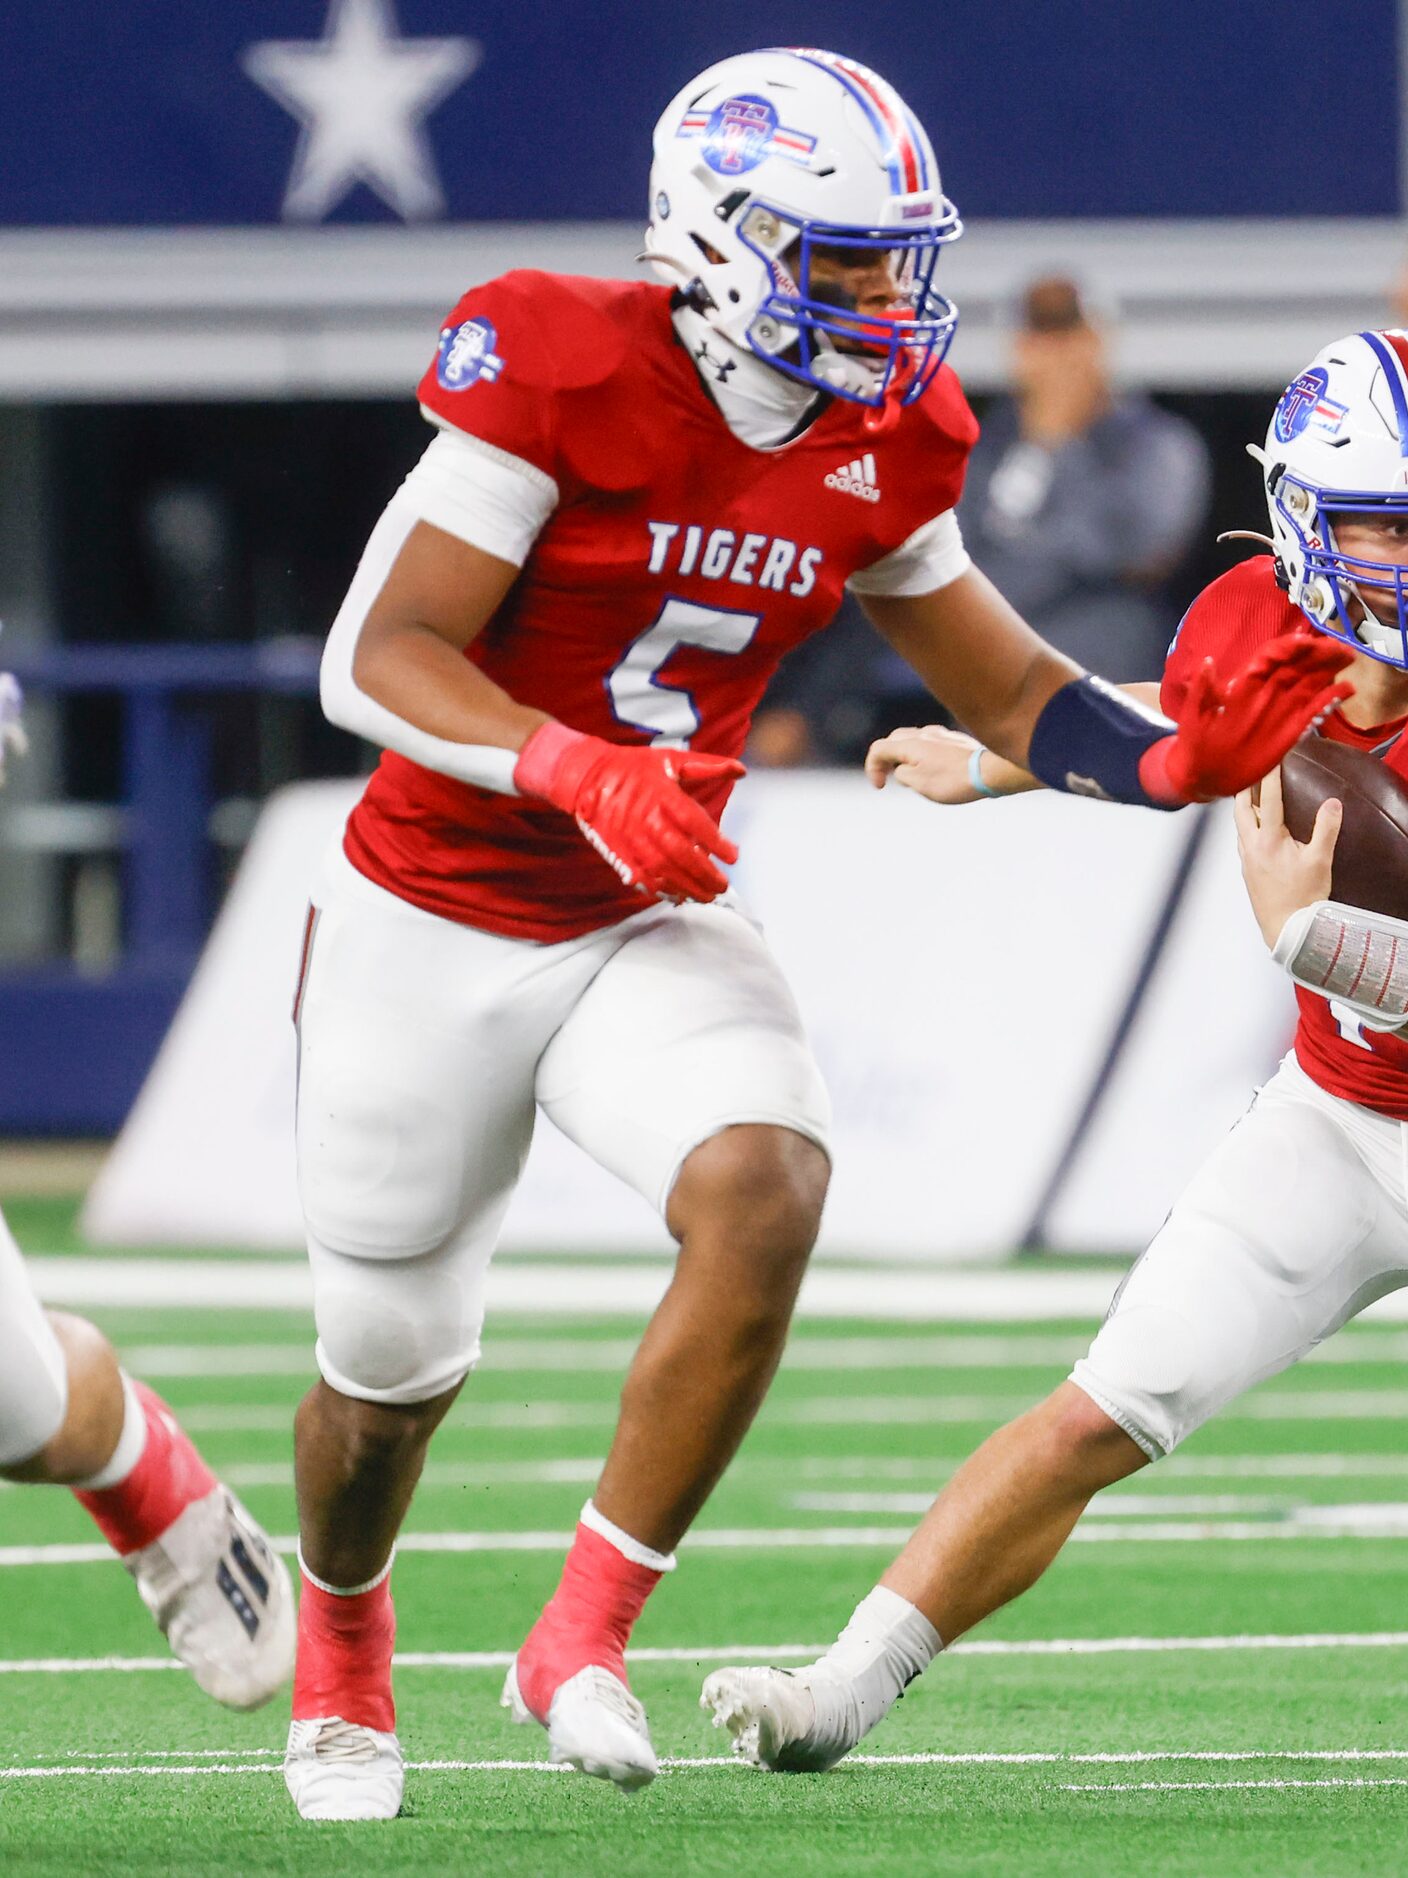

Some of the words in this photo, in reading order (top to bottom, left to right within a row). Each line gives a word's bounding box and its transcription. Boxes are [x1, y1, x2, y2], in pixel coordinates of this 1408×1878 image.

[824, 474, 880, 504] adidas
[648, 521, 823, 597] TIGERS
[604, 593, 764, 752] 5
